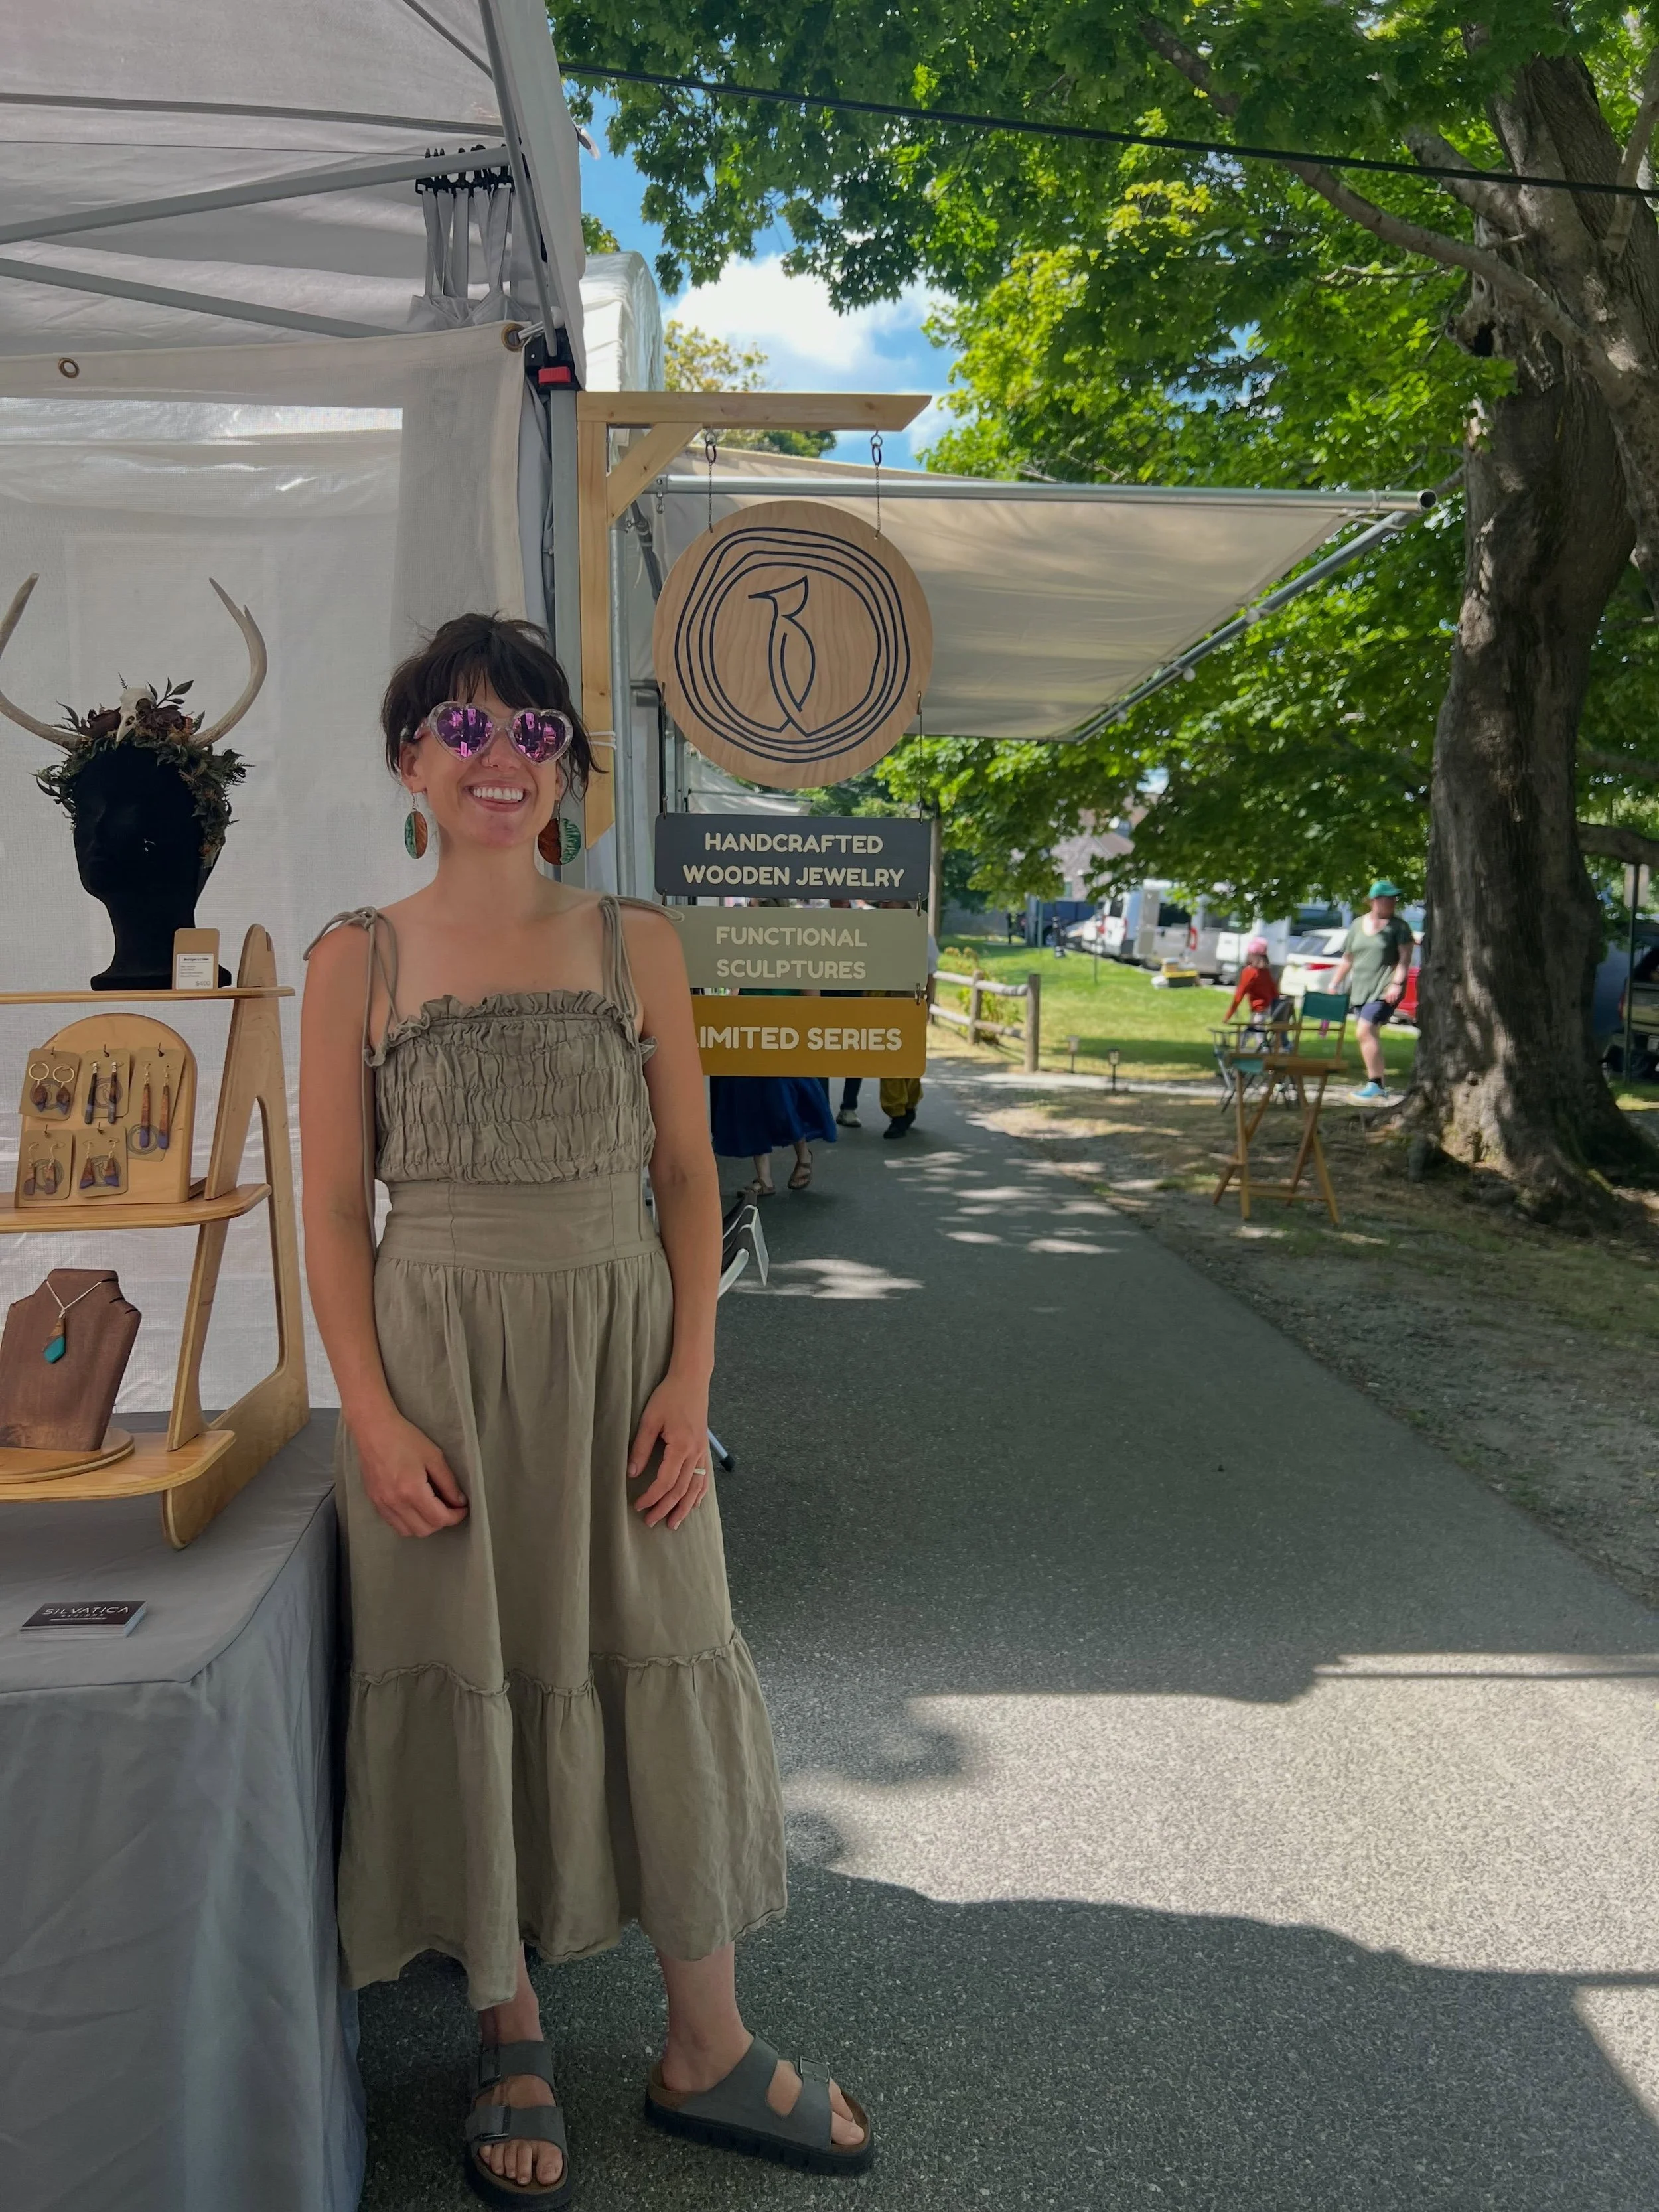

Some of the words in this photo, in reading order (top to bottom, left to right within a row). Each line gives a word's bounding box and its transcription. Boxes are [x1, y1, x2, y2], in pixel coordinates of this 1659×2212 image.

[705, 832, 883, 854] HANDCRAFTED
[682, 865, 790, 885] WOODEN
[795, 867, 905, 887] JEWELRY
[716, 926, 868, 947] FUNCTIONAL
[717, 959, 867, 980] SCULPTURES
[697, 1026, 800, 1049] IMITED
[807, 1027, 902, 1051] SERIES
[42, 1606, 129, 1615] SILVATICA
